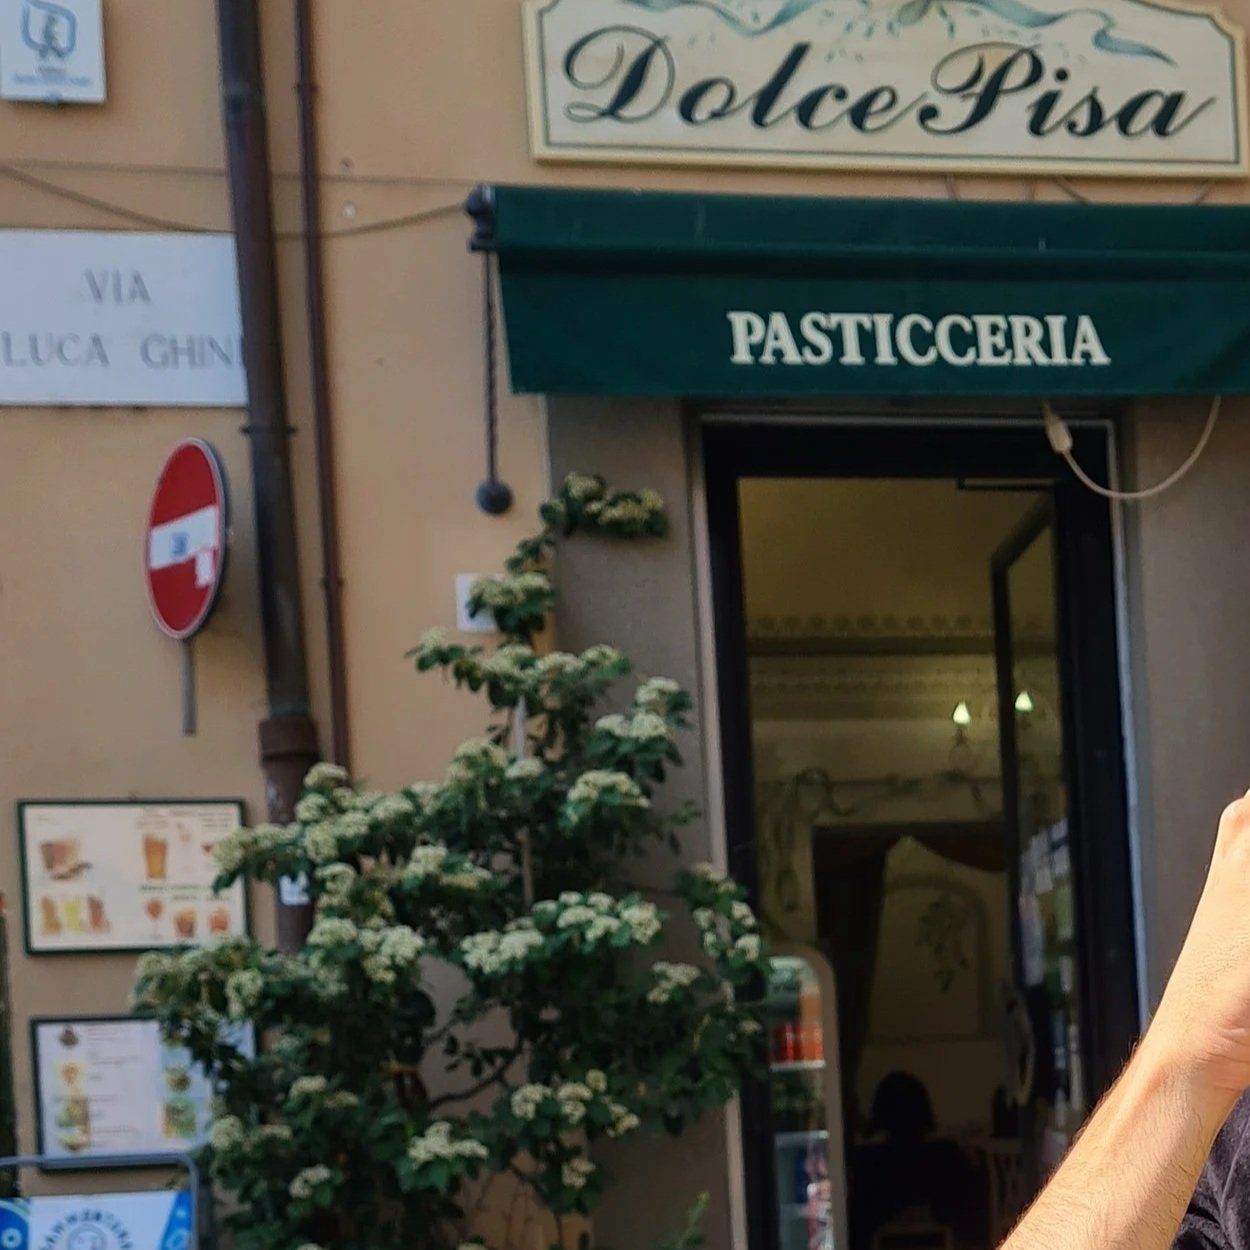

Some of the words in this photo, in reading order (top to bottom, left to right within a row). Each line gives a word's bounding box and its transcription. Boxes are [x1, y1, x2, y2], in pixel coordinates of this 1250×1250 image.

[562, 24, 928, 135] Dolce
[915, 41, 1217, 141] Pisa
[84, 268, 151, 305] VIA
[0, 329, 111, 368] LUCA
[725, 310, 1112, 368] PASTICCERIA
